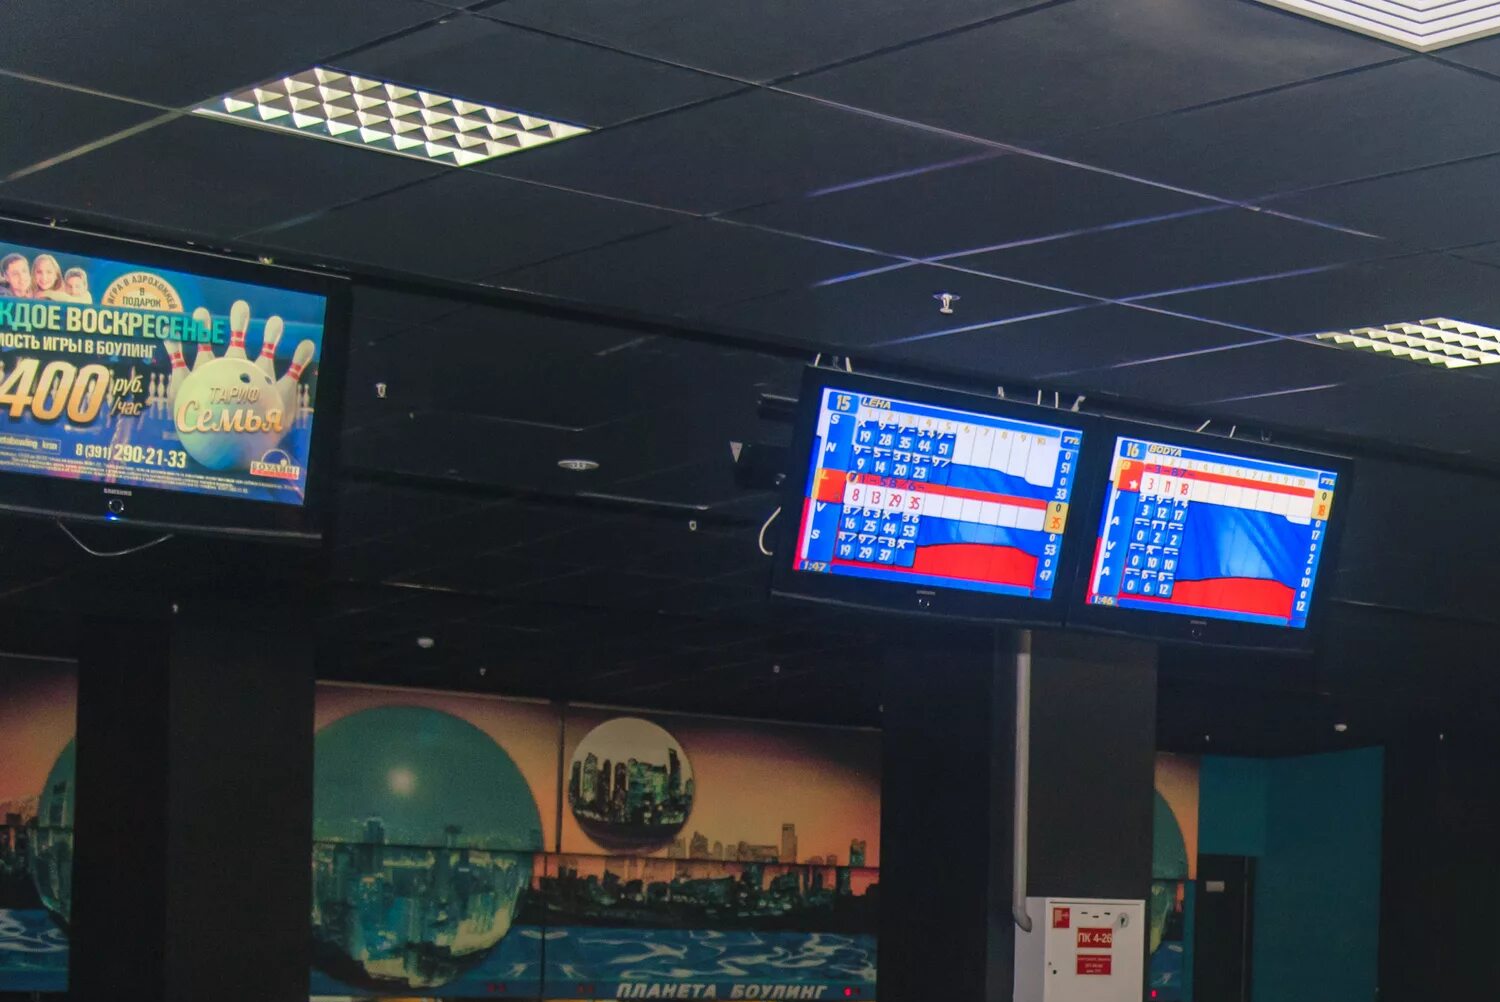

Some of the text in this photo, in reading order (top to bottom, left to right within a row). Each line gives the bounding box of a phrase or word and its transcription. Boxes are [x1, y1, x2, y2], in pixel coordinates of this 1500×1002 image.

[122, 296, 161, 308] ПОДАРОК
[66, 307, 224, 344] ВОСКРЕСЕНЬЕ
[43, 337, 82, 353] ИГРЫ
[85, 340, 94, 355] В
[96, 341, 157, 359] БОУЛИНГ
[0, 358, 110, 424] 400
[113, 374, 143, 394] руб.
[210, 386, 259, 405] ТАРИФ
[836, 394, 891, 411] 15 LEHA
[110, 399, 142, 416] /час
[177, 400, 283, 433] Семья
[860, 431, 871, 442] 19
[878, 434, 892, 446] 28
[75, 443, 187, 469] 8 (391) 290-21-33
[1127, 442, 1139, 458] 16
[857, 458, 926, 479] 9 14 20 23
[1093, 933, 1112, 944] 4-26
[616, 982, 828, 999] ПЛАНЕТА БОУЛИНГ
